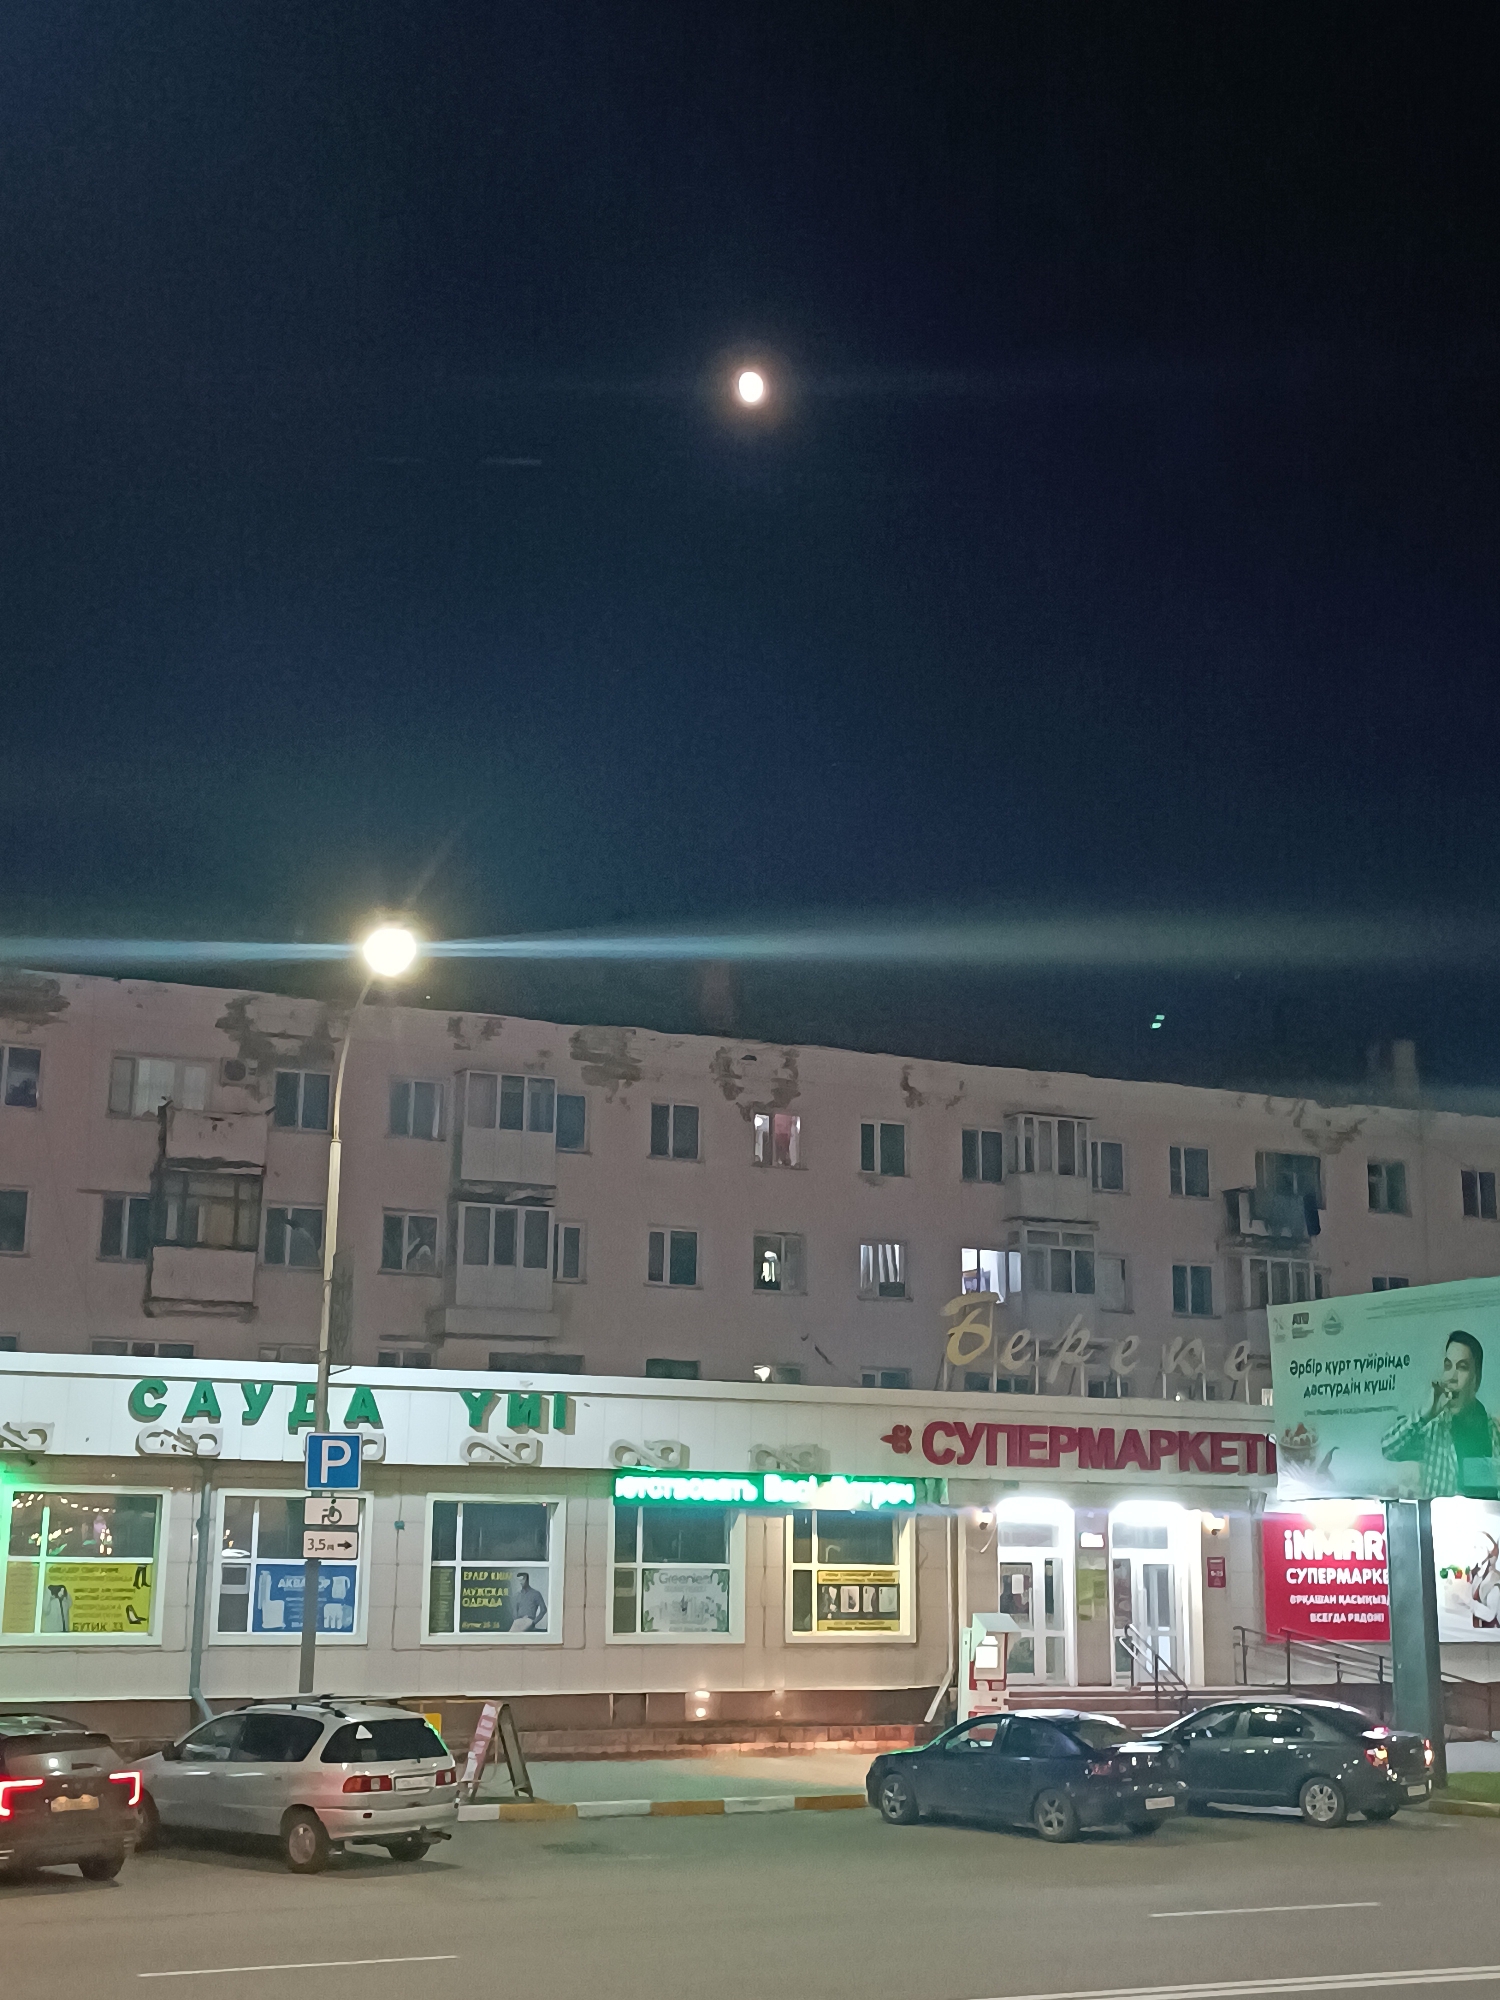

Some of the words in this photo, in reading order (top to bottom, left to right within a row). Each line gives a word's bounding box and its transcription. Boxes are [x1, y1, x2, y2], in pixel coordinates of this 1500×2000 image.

[1290, 1358, 1322, 1378] Әрбір
[128, 1378, 383, 1434] САУДА
[1284, 1529, 1388, 1560] iNMAR
